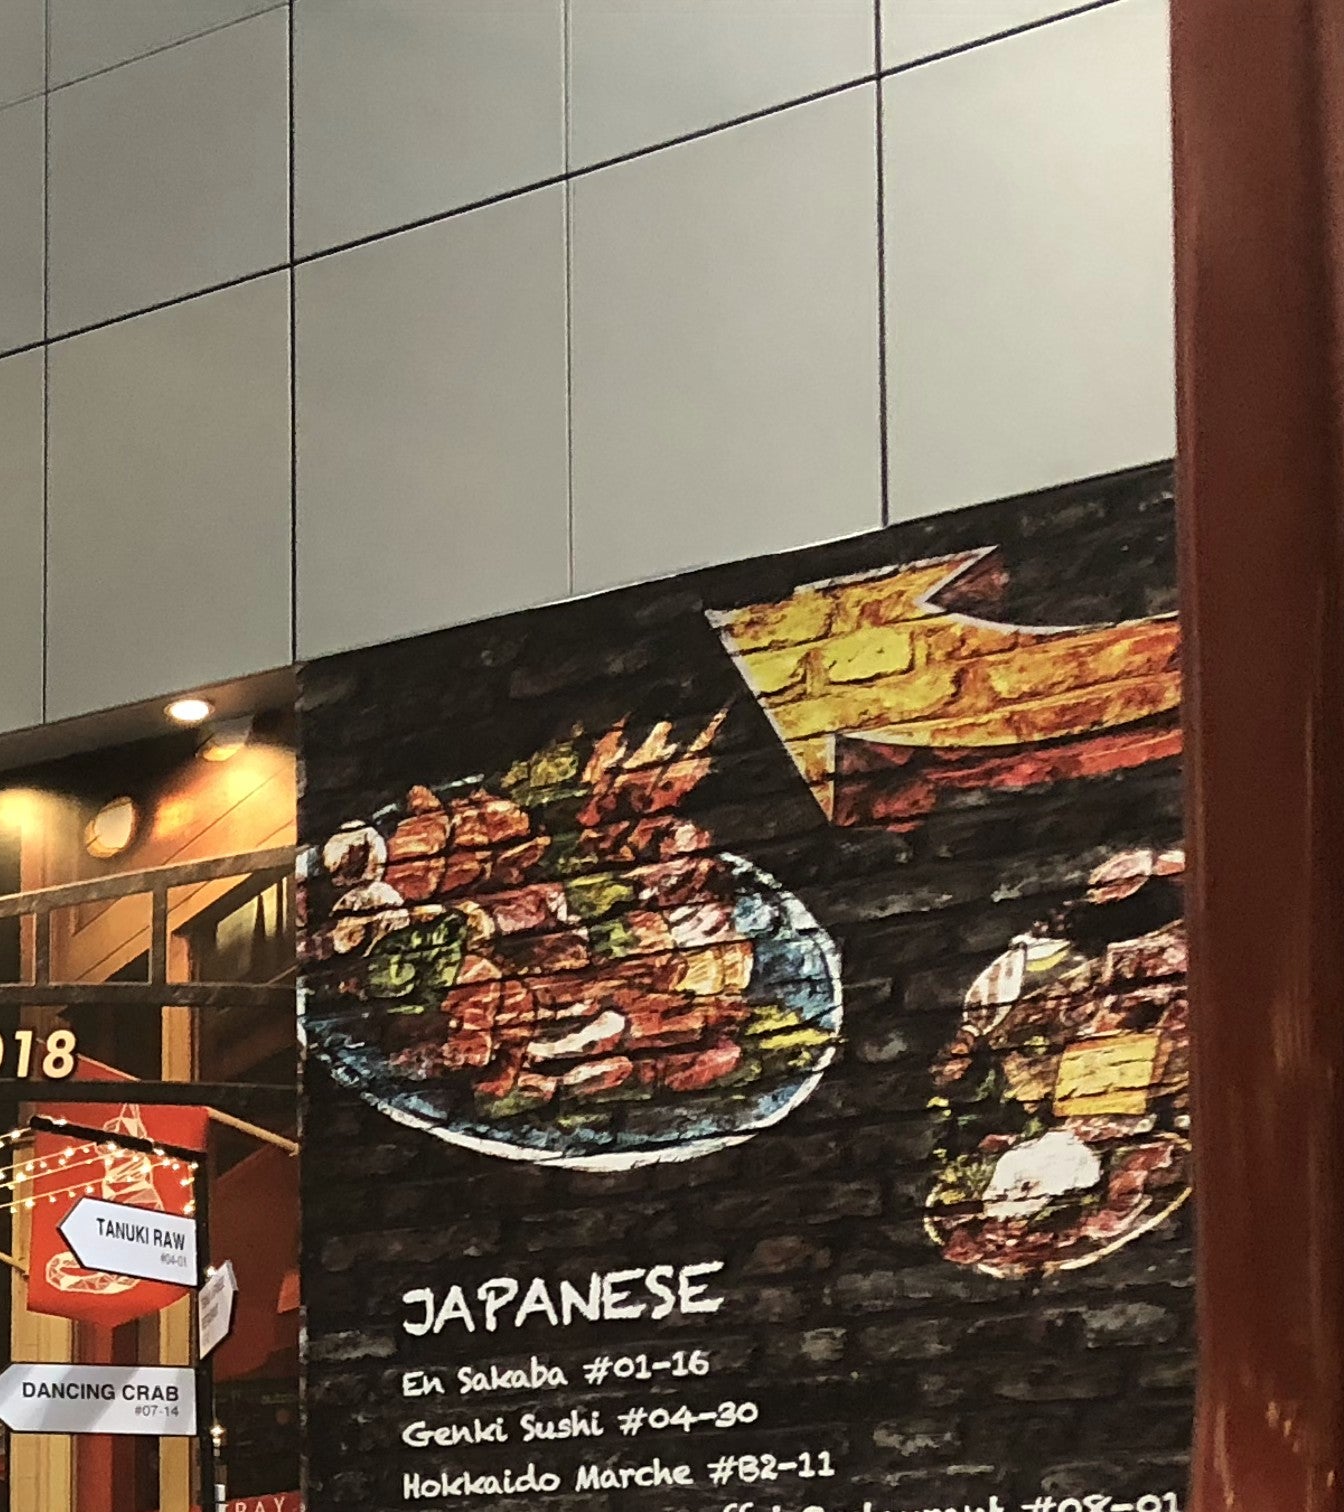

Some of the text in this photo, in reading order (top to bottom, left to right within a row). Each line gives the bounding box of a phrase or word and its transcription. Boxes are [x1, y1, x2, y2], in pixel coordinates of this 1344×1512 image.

[96, 1217, 186, 1251] TANUKI RAW
[402, 1260, 725, 1336] JAPANESE
[22, 1382, 180, 1402] DANCING CRAB
[402, 1350, 710, 1397] En Sakaba #01-16
[134, 1405, 180, 1417] #07-14
[402, 1402, 759, 1448] Genki Sushi #04-30
[403, 1451, 836, 1500] Hokkaido Marche #B2-11
